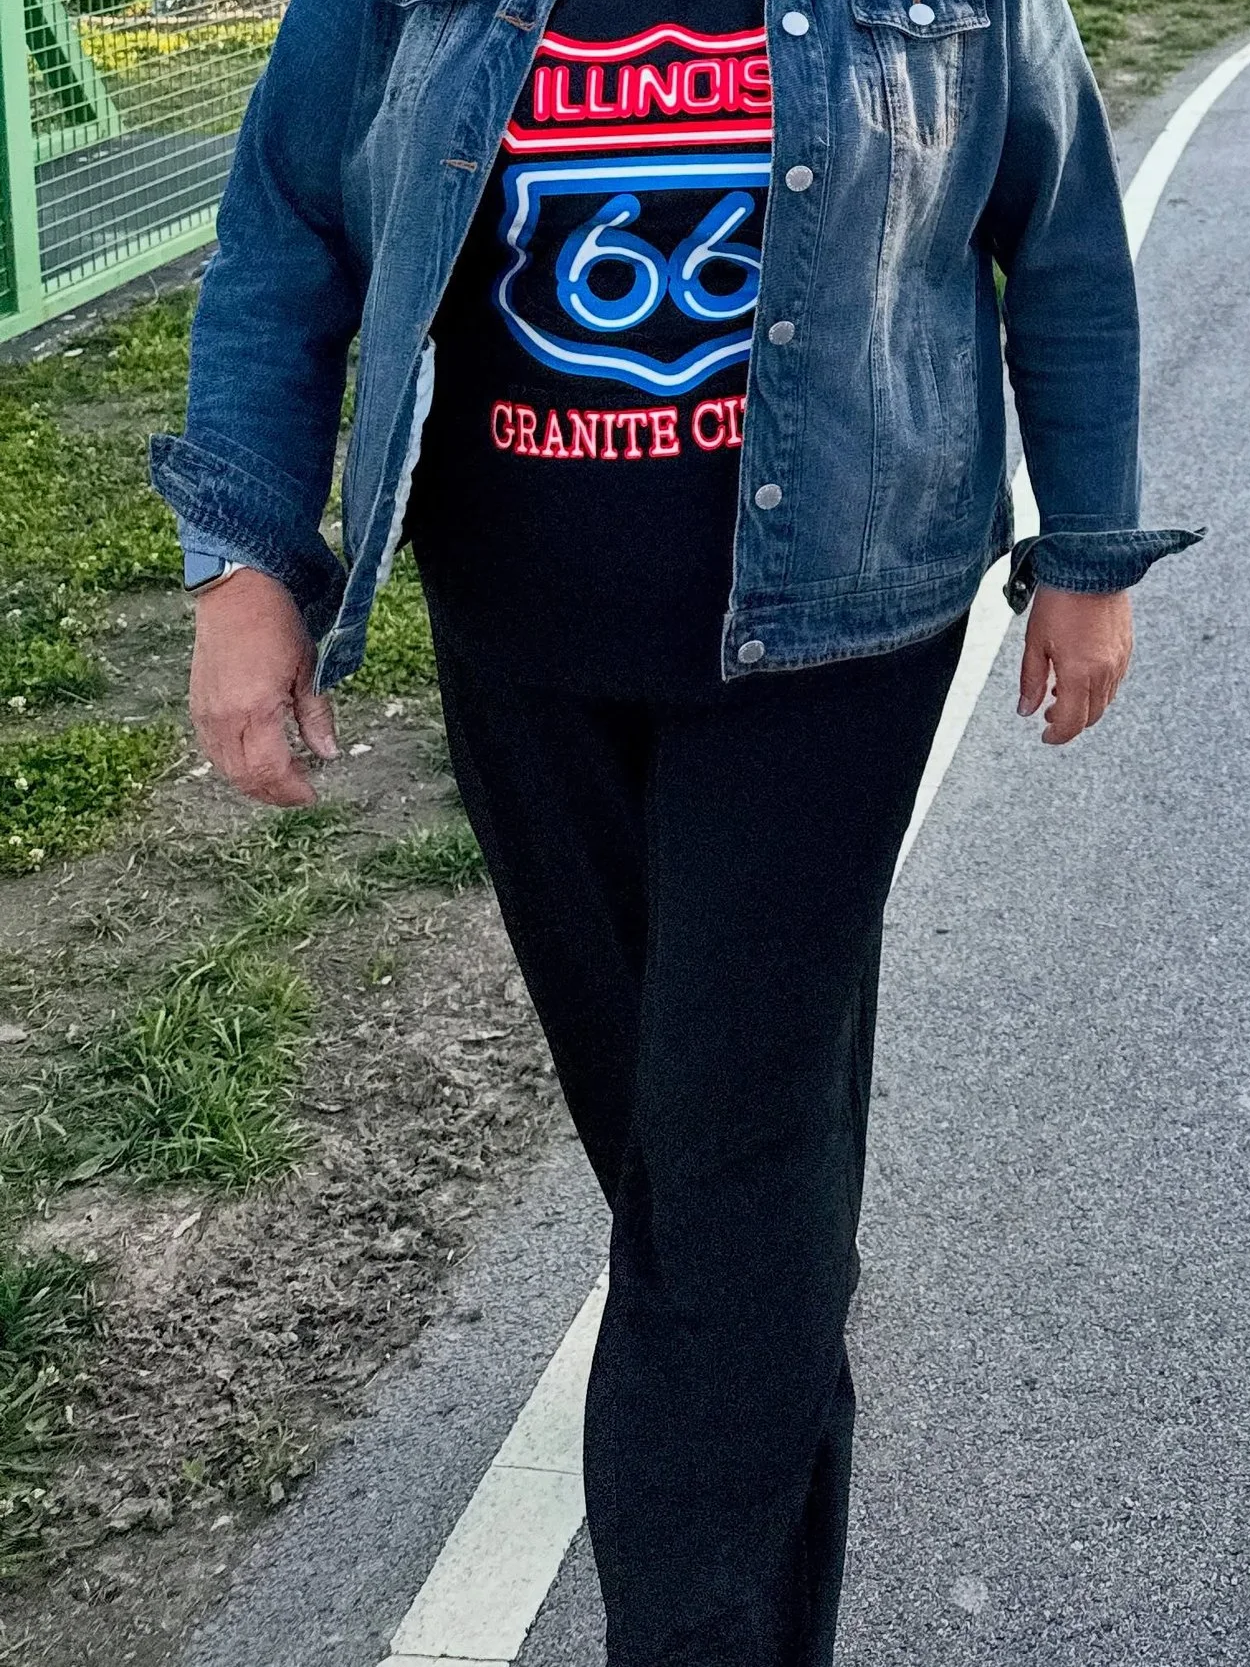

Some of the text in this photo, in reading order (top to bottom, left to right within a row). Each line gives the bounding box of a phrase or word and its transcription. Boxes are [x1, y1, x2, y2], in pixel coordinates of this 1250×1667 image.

[534, 57, 773, 121] ILLINOIS
[555, 191, 764, 332] 66
[491, 395, 748, 459] GRANITE CI
